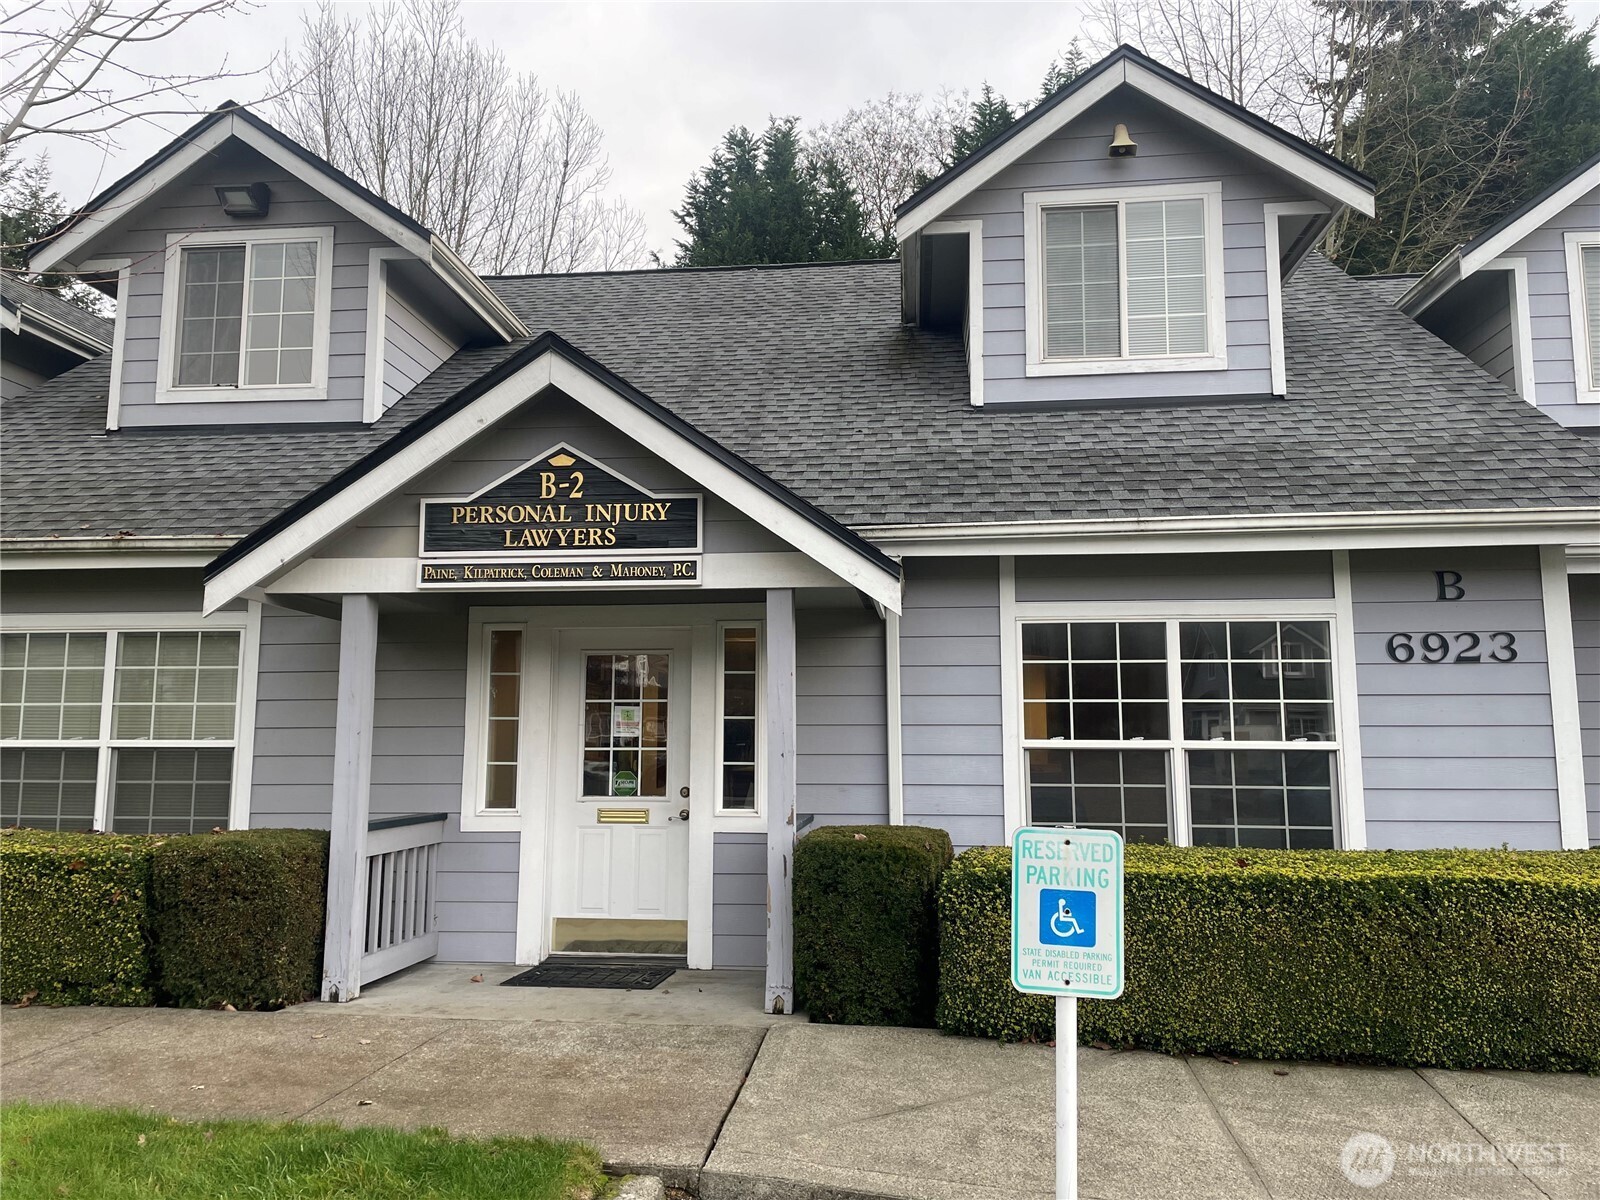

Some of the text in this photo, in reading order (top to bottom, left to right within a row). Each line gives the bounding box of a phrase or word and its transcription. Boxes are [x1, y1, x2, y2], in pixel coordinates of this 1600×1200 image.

[540, 471, 584, 499] B-2
[451, 502, 671, 525] PERSONAL INJURY
[503, 527, 616, 547] LAWYERS
[423, 562, 694, 580] PAINE, KILPATRICK, COLEMAN & MAHONEY, P.C.
[1434, 570, 1465, 602] B
[1385, 632, 1518, 664] 6923
[1022, 839, 1113, 863] RESERVED
[1026, 865, 1109, 889] PARKING
[1022, 948, 1113, 962] STATE DISABLED PARKING
[1032, 959, 1102, 972] PERMIT REQUIRED
[1022, 969, 1113, 986] VAN ACCESSIBLE
